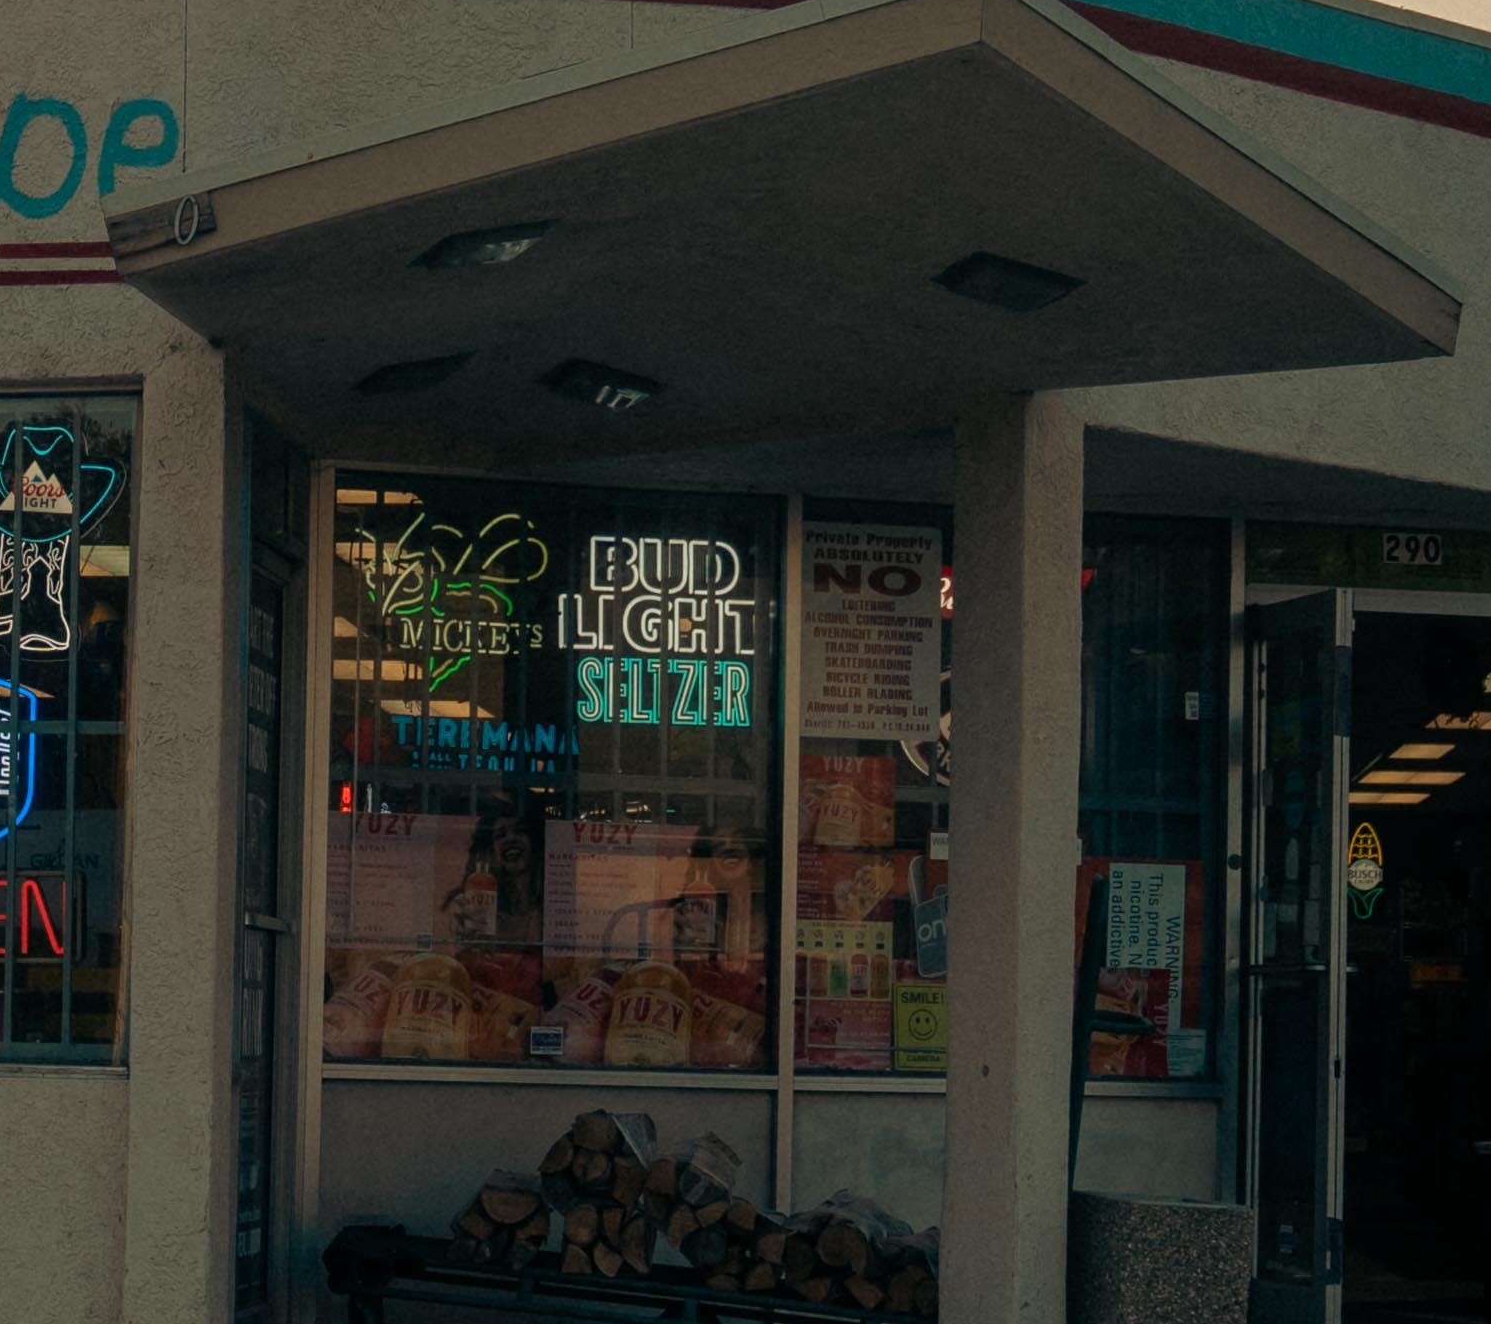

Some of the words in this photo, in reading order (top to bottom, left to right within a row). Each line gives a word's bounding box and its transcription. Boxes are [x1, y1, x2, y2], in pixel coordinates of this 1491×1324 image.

[21, 497, 58, 509] IGHT
[805, 530, 859, 545] Private
[866, 533, 933, 550] Property
[1386, 535, 1440, 563] 290
[590, 536, 740, 595] BUD
[813, 548, 925, 564] ABSOLUTELY
[813, 563, 922, 596] NO
[842, 599, 896, 612] LOITERING
[558, 592, 757, 655] LIGHT
[805, 611, 851, 624] ALCOHOL
[856, 614, 933, 628] CONSUMPTION
[813, 626, 872, 640] OVERNIGHT
[877, 628, 924, 642] PARKING
[825, 641, 859, 654] TRASH
[864, 643, 913, 656] DUMPING
[825, 657, 912, 671] SKATEBOARDING
[826, 672, 868, 685] BICYCLE
[874, 673, 910, 686] RIDING
[577, 656, 753, 729] SELTZER
[823, 685, 861, 698] ROLLER
[867, 688, 913, 701] BLADING
[807, 700, 849, 714] Allowed
[853, 702, 862, 714] in
[868, 703, 908, 717] Parking
[912, 705, 929, 716] Lot
[821, 755, 865, 773] YUZY
[572, 822, 637, 844] YUZY
[1112, 870, 1124, 890] an
[1347, 869, 1382, 879] BUSCH
[1148, 872, 1164, 906] This
[1109, 894, 1125, 970] addictive
[1146, 911, 1162, 967] produc
[396, 988, 463, 1027] YUZY
[618, 996, 684, 1034] YUZY
